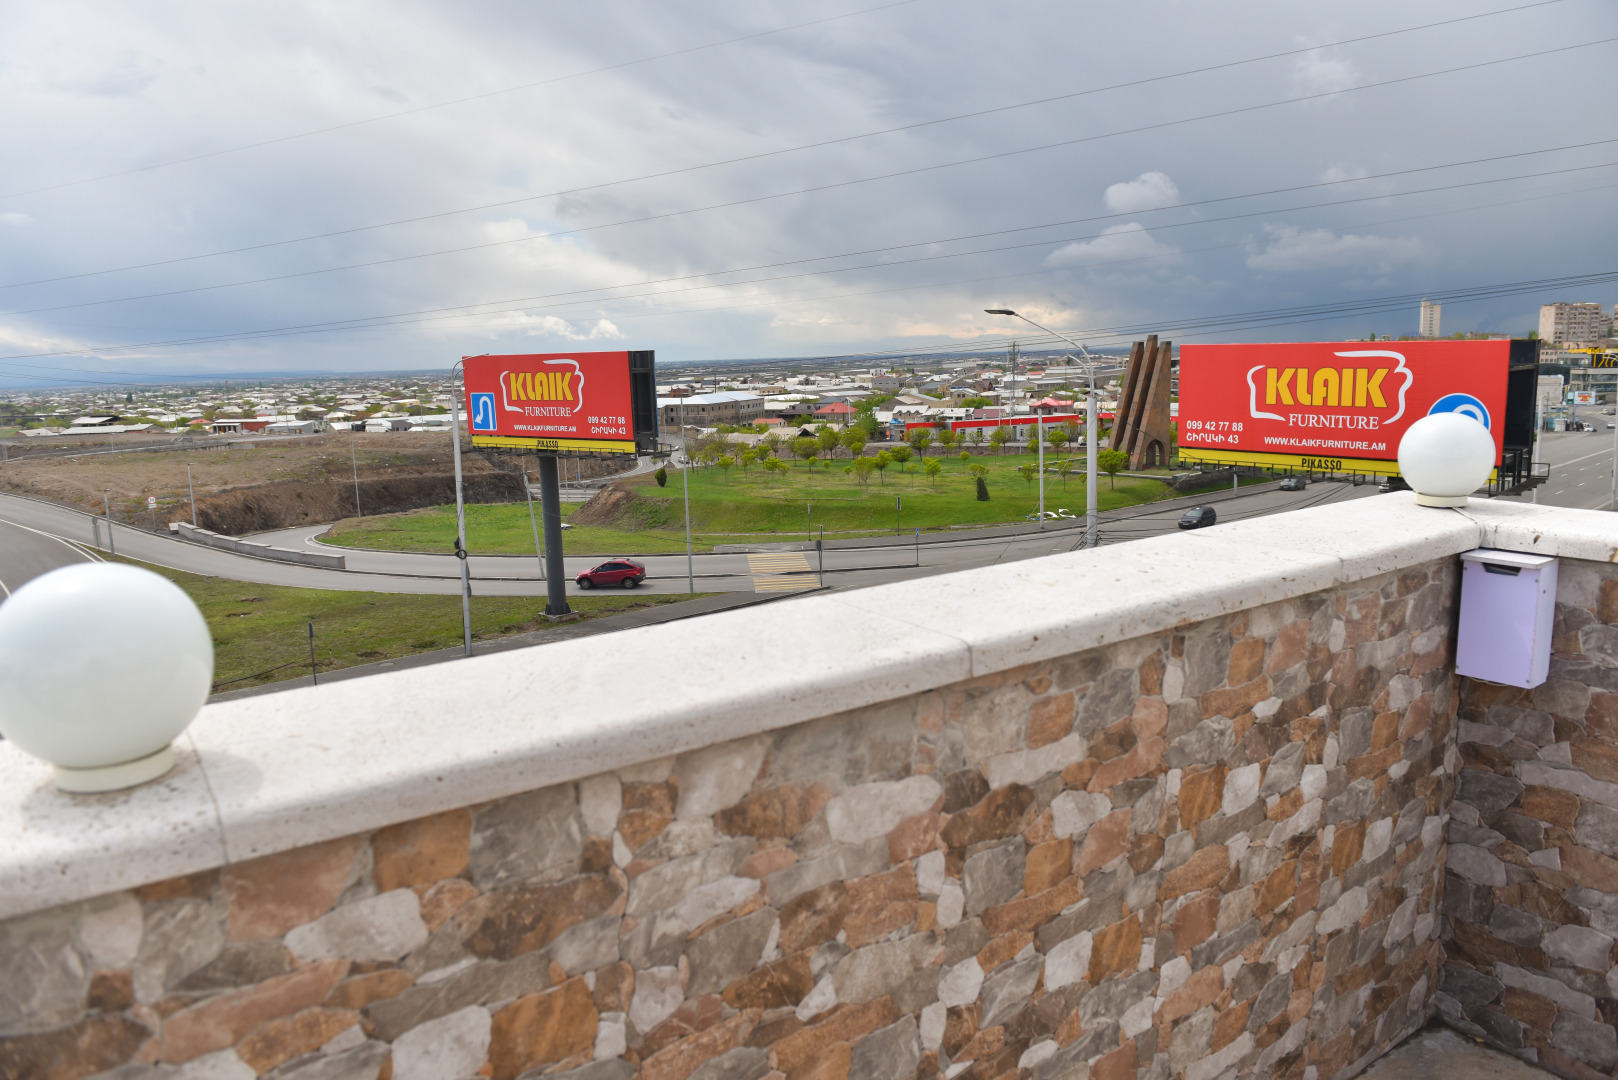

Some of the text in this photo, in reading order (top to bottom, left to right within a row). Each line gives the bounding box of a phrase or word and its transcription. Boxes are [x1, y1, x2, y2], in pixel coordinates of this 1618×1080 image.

[509, 371, 574, 401] KLAIK
[1265, 367, 1390, 408] KLAIK
[524, 406, 572, 417] FURNITURE
[587, 416, 626, 425] 099 42 77 88
[1186, 420, 1244, 432] 099 42 77 88
[1288, 413, 1380, 430] FURNITURE
[513, 424, 577, 433] WWW.KLAIKFURNITURE.AM
[618, 426, 627, 435] 43
[536, 439, 559, 449] PIKASSO
[1227, 434, 1239, 444] 43
[1264, 436, 1387, 451] WWW.KLAIKFURNITURE.AM
[1301, 457, 1342, 471] PIKASSO
